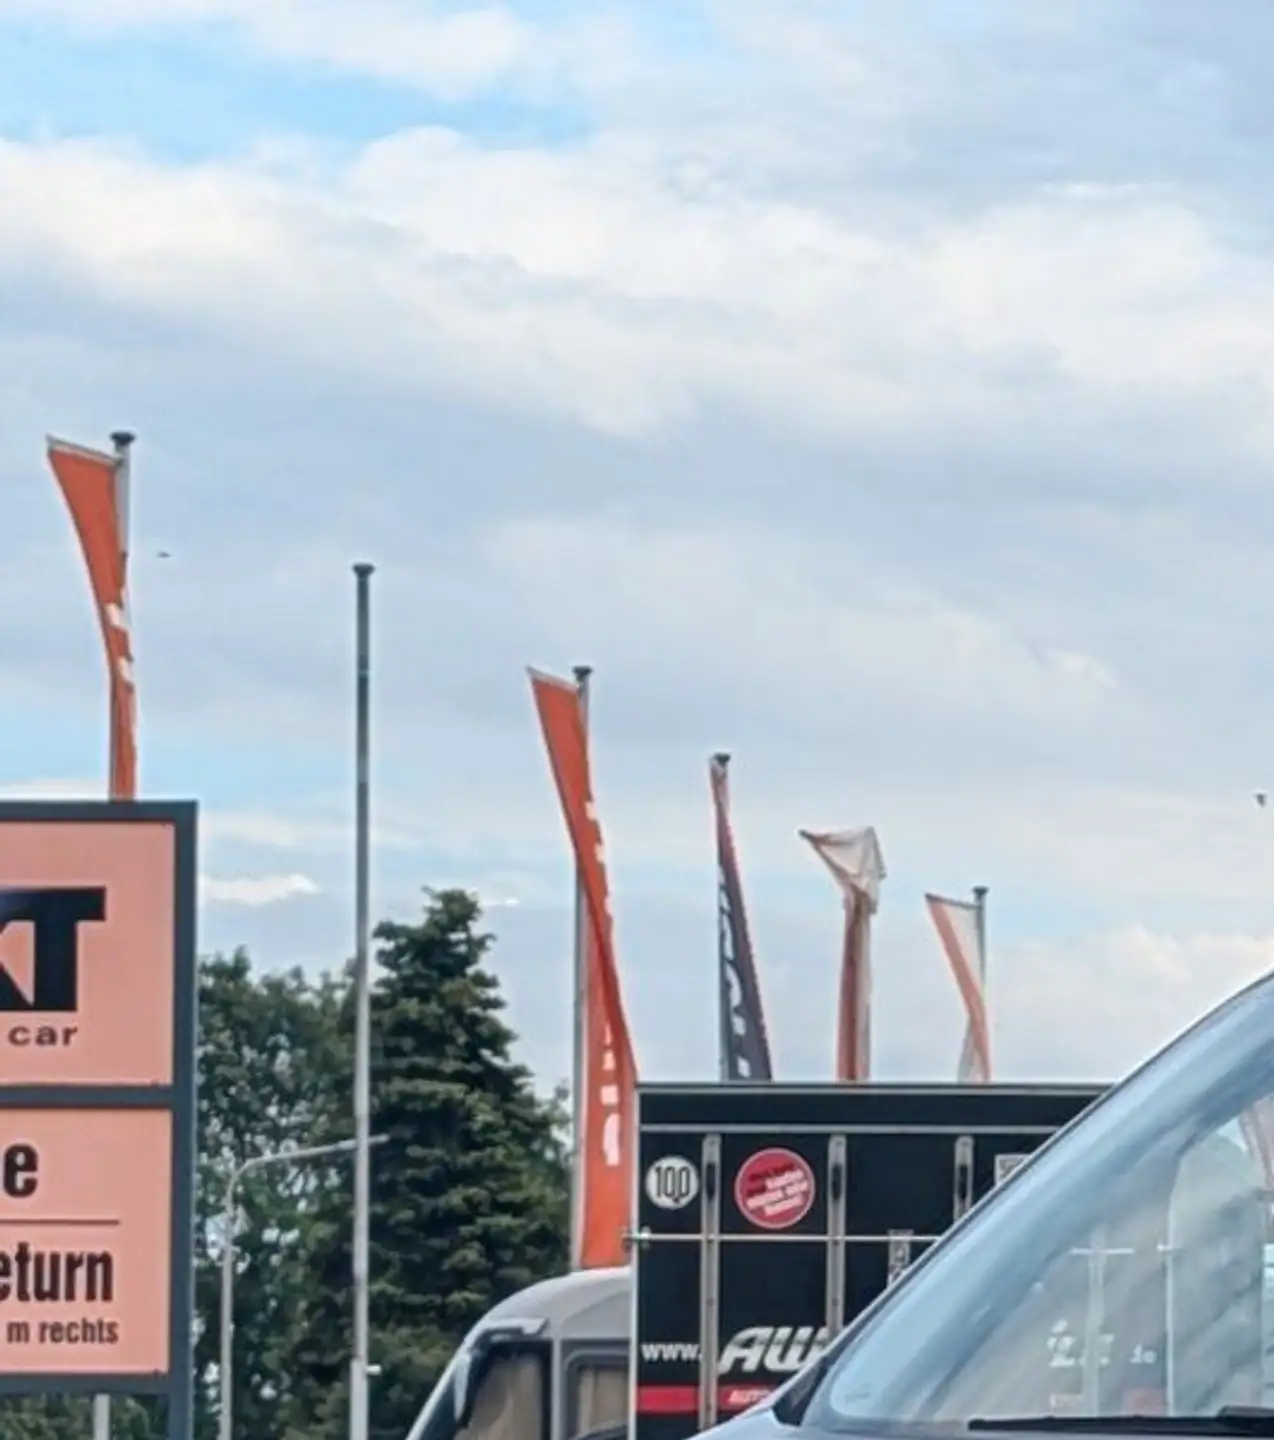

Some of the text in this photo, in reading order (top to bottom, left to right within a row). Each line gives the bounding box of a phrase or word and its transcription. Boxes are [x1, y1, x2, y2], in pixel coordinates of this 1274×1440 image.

[8, 1024, 78, 1046] car
[655, 1166, 690, 1200] 100
[7, 1318, 119, 1344] m rechts
